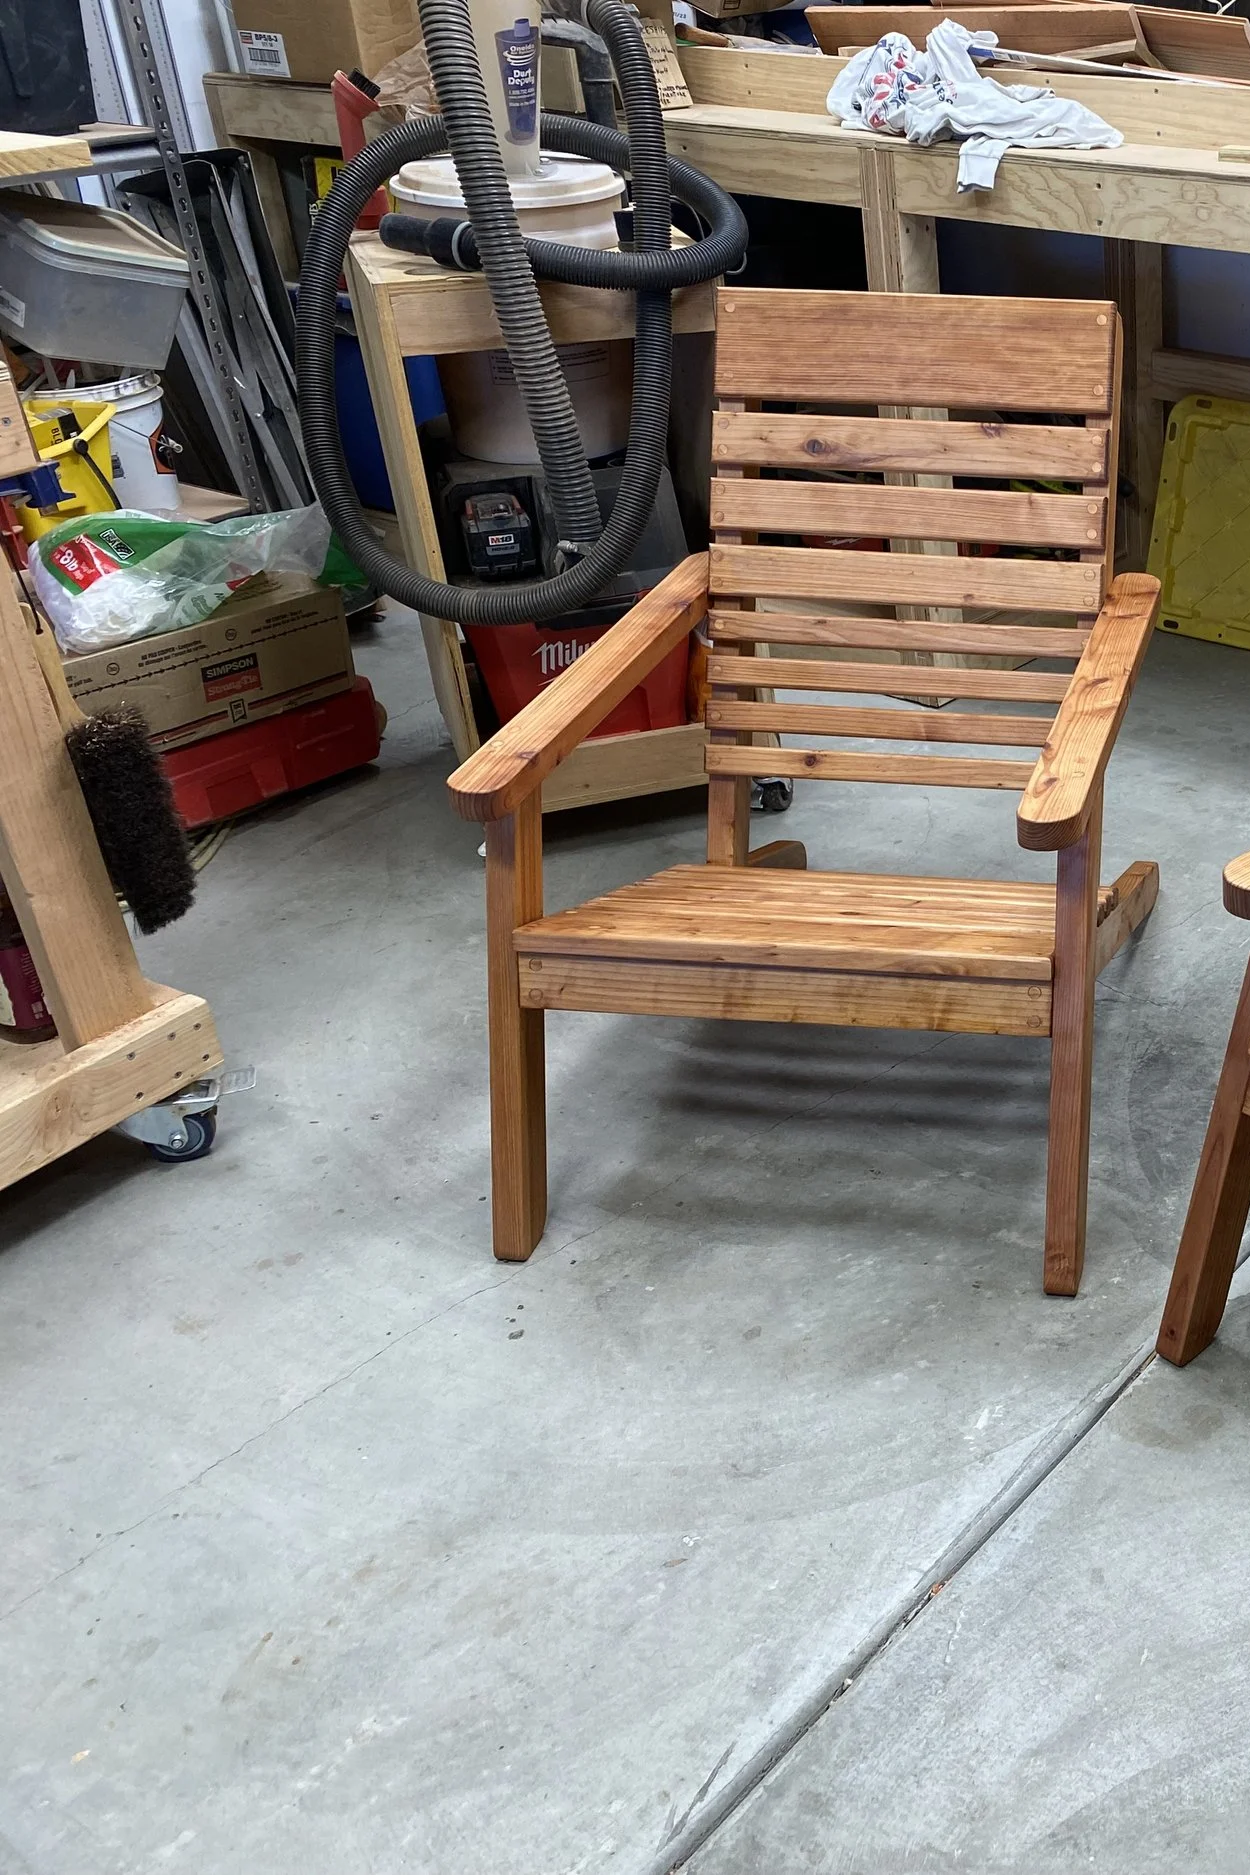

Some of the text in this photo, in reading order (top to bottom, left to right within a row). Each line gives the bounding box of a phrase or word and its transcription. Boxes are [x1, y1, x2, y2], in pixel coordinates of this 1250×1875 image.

[513, 68, 531, 78] Dust
[507, 76, 535, 87] Deputy
[490, 535, 513, 545] M18
[206, 656, 254, 678] SIMPSON
